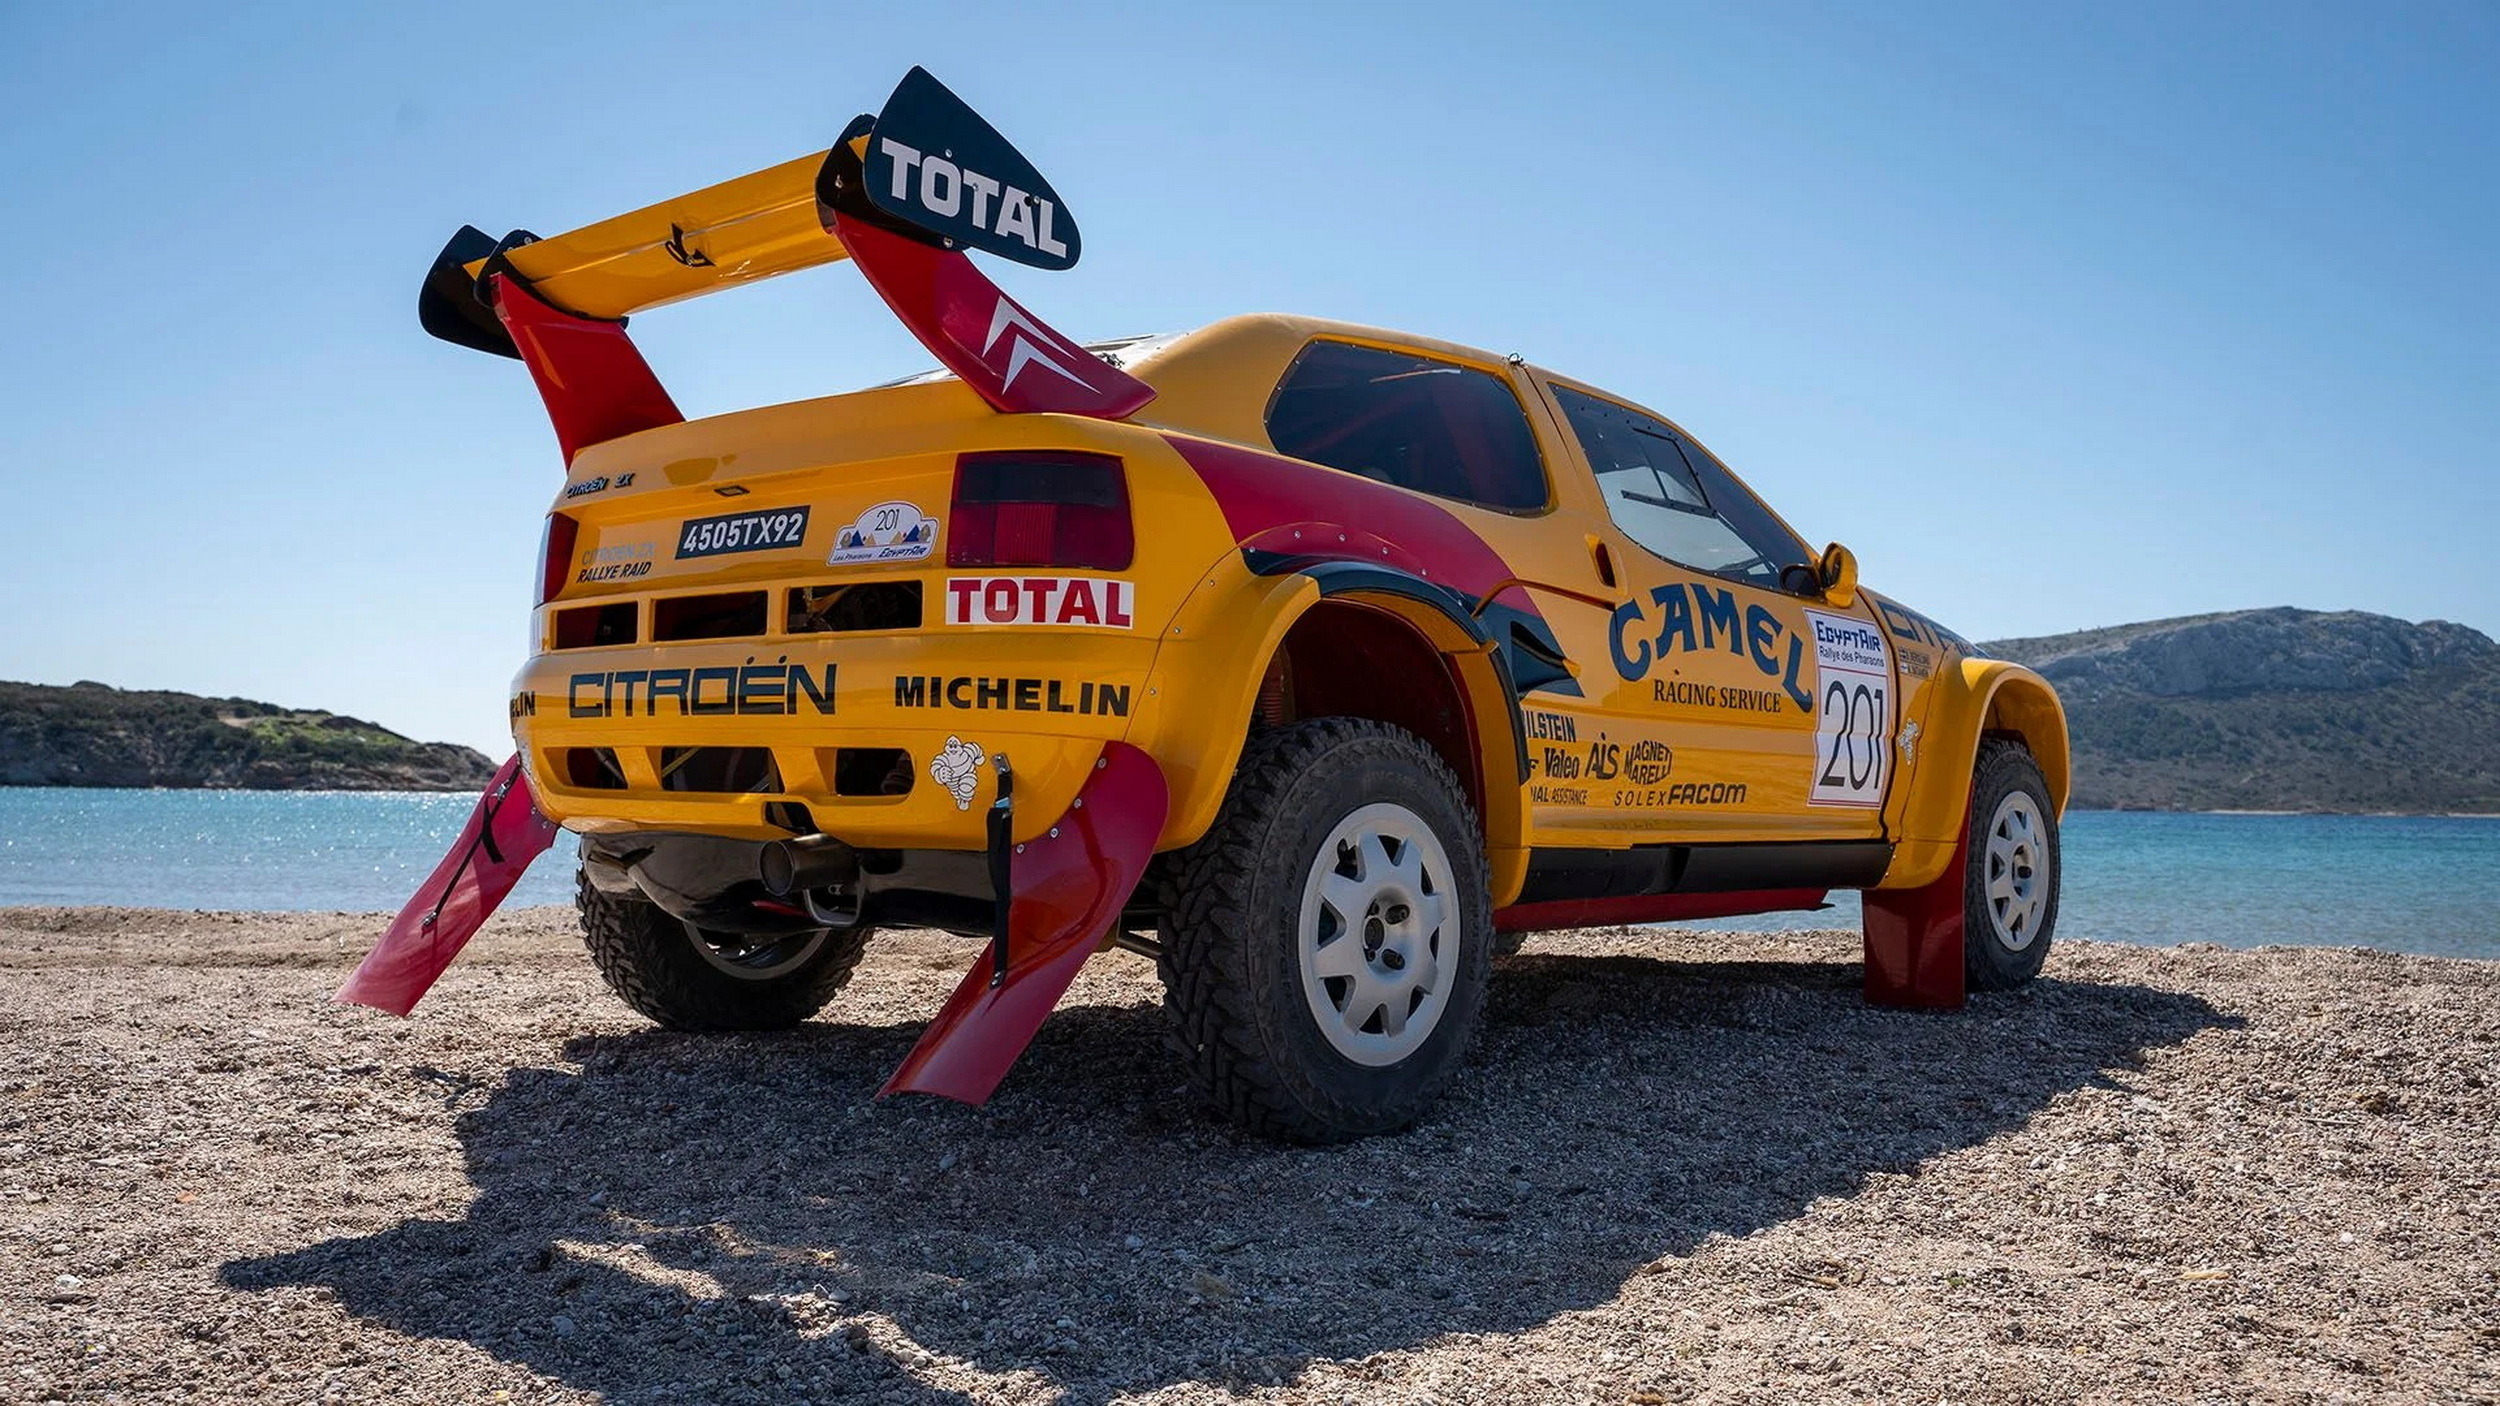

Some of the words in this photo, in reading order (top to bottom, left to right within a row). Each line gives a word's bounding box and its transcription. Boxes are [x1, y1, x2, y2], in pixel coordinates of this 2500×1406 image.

[882, 137, 1067, 259] TOTAL
[684, 512, 804, 552] 4505TX92
[875, 508, 900, 532] 201
[576, 564, 621, 584] RALLYE
[620, 561, 652, 578] RAID
[949, 578, 1131, 628] TOTAL
[1609, 582, 1813, 713] CAMEL
[1819, 645, 1840, 662] Rallye
[1841, 650, 1853, 662] des
[1854, 651, 1885, 667] Pharaons
[569, 655, 838, 718] CITROËN
[895, 676, 1131, 717] MICHELIN
[1653, 678, 1716, 707] RACING
[1719, 686, 1781, 713] SERVICE
[1525, 710, 1577, 743] ILSTEIN
[1819, 680, 1884, 791] 201
[1543, 747, 1580, 780] Valeo
[1614, 790, 1667, 807] SOLEX
[1667, 782, 1748, 805] FACOM
